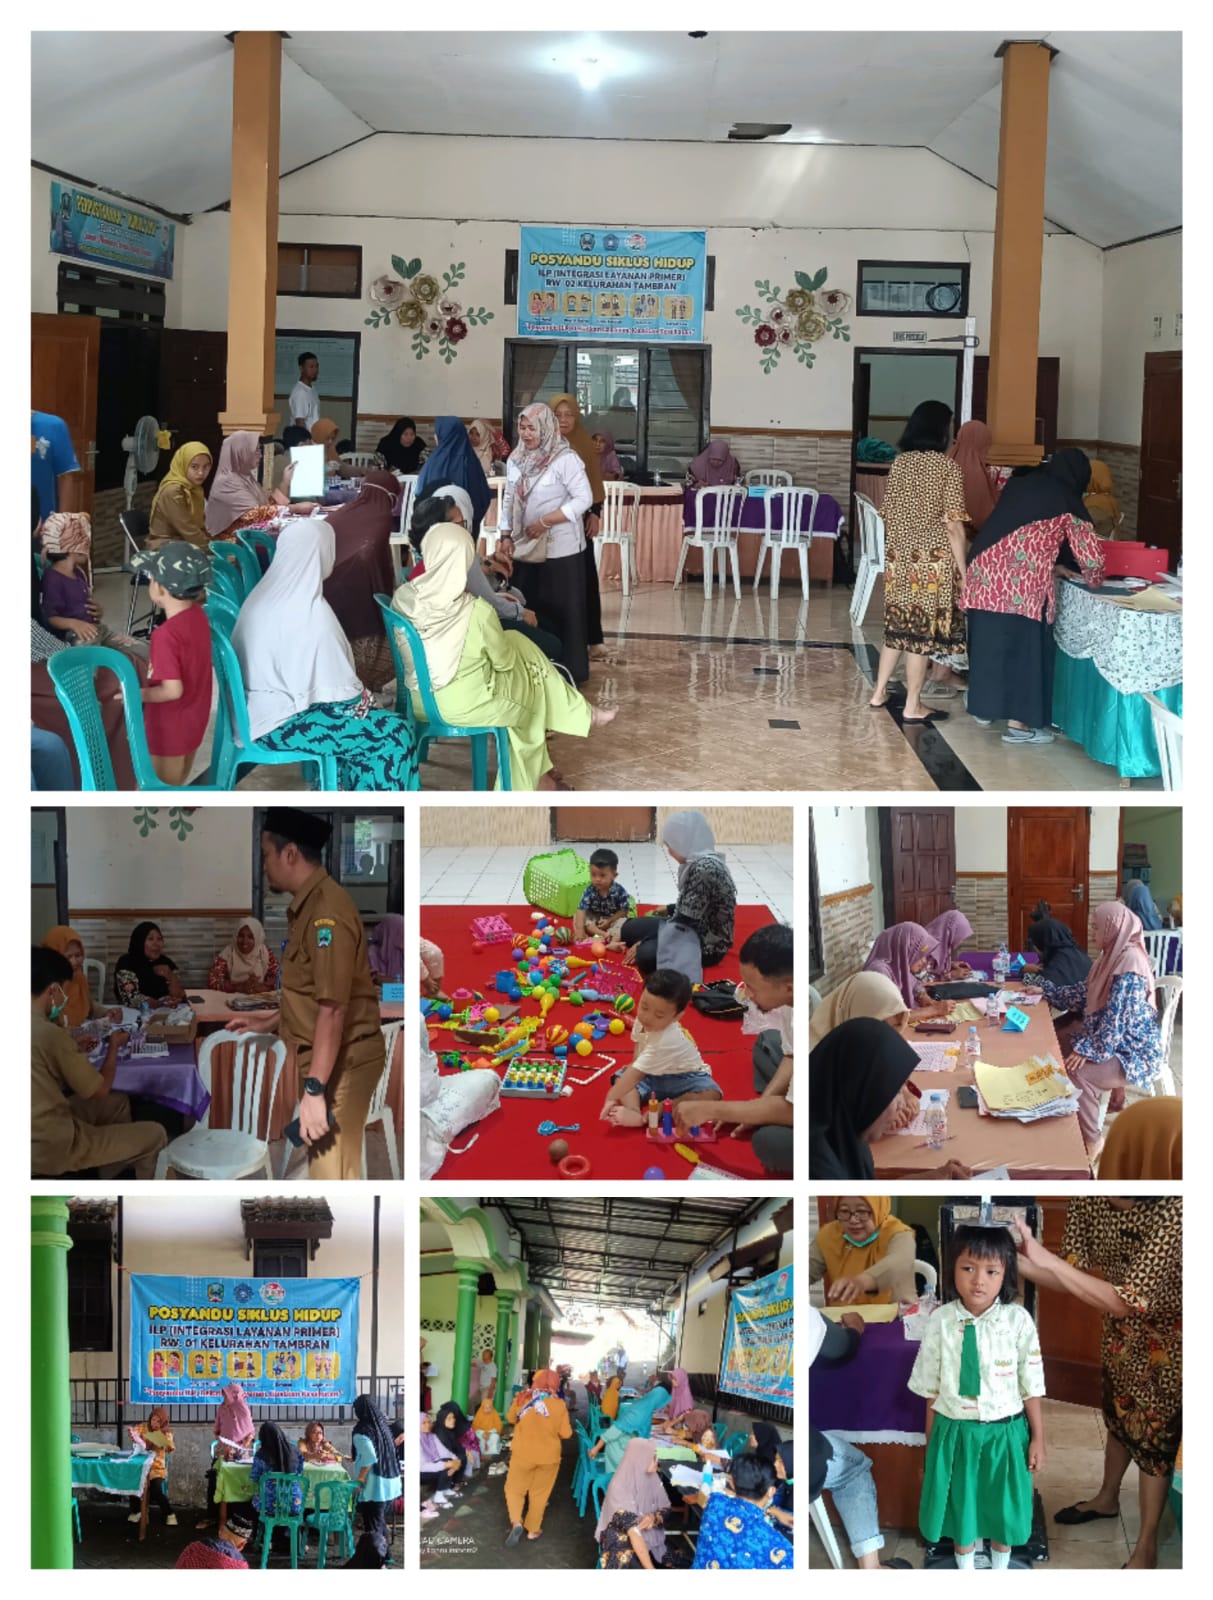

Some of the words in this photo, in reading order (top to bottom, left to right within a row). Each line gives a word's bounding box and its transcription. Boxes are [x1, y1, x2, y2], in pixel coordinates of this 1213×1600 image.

[530, 252, 602, 267] POSYANDU
[605, 255, 651, 269] SIKLUS
[653, 256, 695, 270] HIDUP
[538, 269, 552, 277] ILP
[605, 271, 647, 280] LAYANAN
[577, 280, 631, 289] KELURAHAN
[633, 282, 677, 290] TAMBRAN
[148, 1306, 234, 1322] POSYANDU
[237, 1307, 290, 1323] SIKLUS
[293, 1307, 341, 1323] HIDUP
[149, 1325, 167, 1335] ILP
[236, 1326, 291, 1337] LAYANAN
[185, 1338, 197, 1348] 01
[201, 1338, 270, 1349] KELURAHAN
[272, 1339, 330, 1350] TAMBRAN
